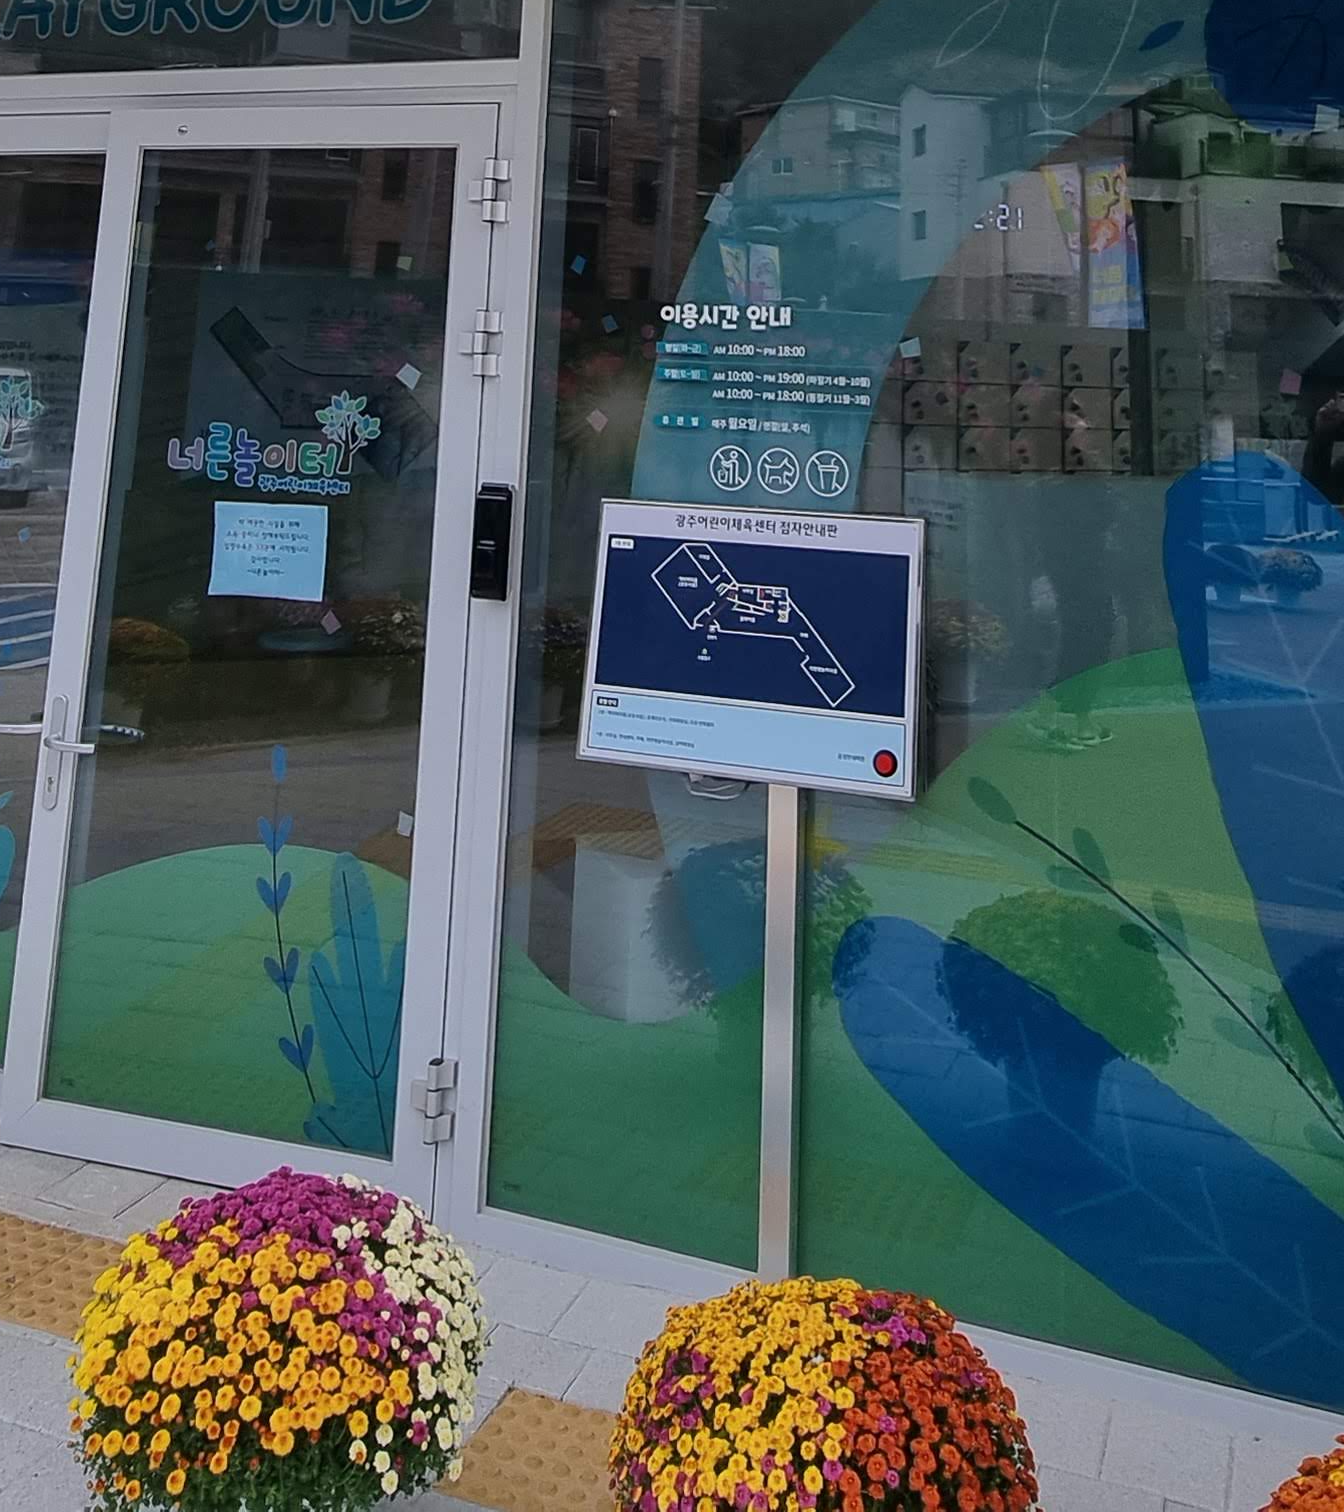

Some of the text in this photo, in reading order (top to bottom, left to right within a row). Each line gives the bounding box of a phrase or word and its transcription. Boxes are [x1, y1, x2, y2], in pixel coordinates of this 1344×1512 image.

[660, 303, 792, 330] 이용시간 안내
[713, 346, 726, 355] AM
[728, 344, 755, 356] 10:00
[763, 348, 776, 356] PM
[777, 346, 806, 357] 18:00
[712, 372, 725, 381] AM
[727, 371, 754, 382] 10:00
[763, 374, 776, 383] PM
[777, 372, 805, 384] 19:00
[712, 390, 725, 399] AM
[727, 388, 753, 400] 10:00
[762, 391, 776, 401] PM
[777, 390, 805, 402] 18:00
[728, 417, 757, 431] 월요일
[167, 422, 338, 487] 너른놀이터
[258, 474, 350, 495] 광주어린이체육센터
[675, 514, 838, 538] 광주어린이체육센터 점자안내판
